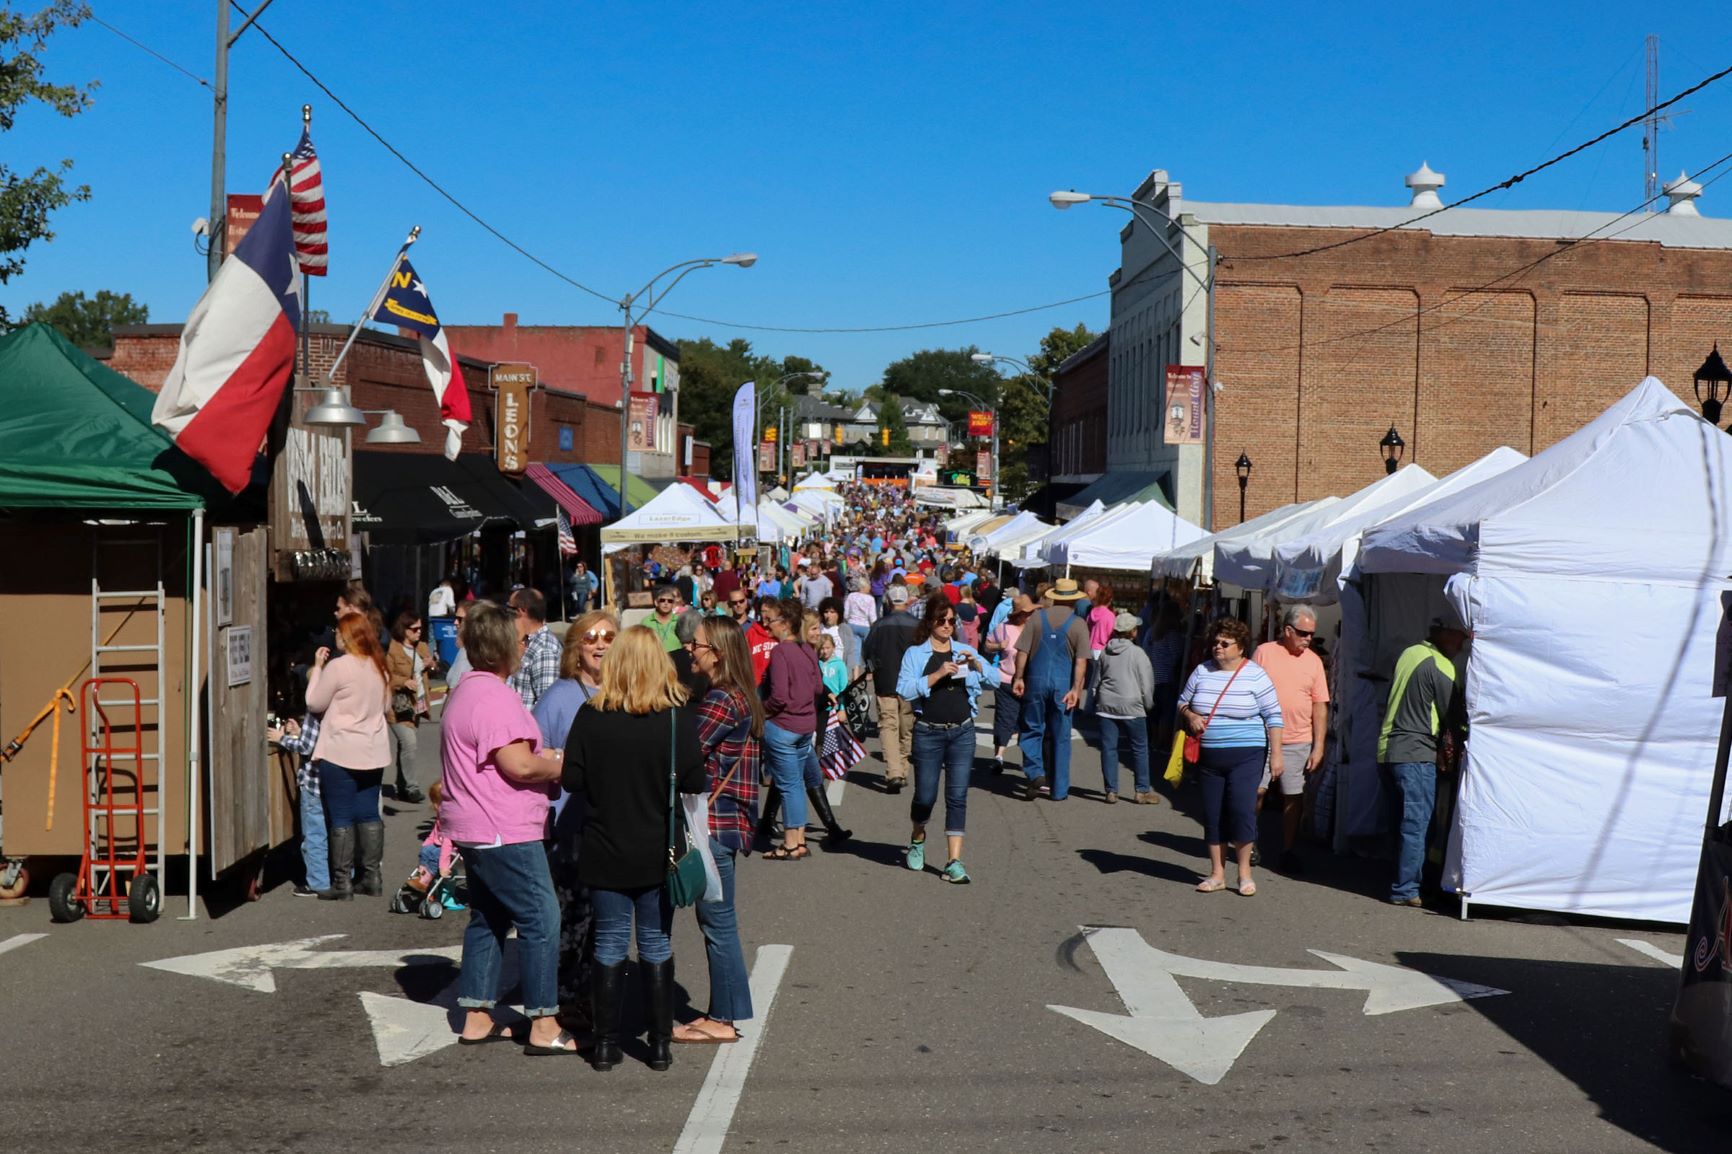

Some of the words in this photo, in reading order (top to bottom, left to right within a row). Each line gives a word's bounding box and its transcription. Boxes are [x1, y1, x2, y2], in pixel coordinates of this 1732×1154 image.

[391, 271, 412, 288] N
[504, 392, 519, 470] LEONS
[352, 513, 383, 523] ewelers
[762, 641, 779, 651] STA
